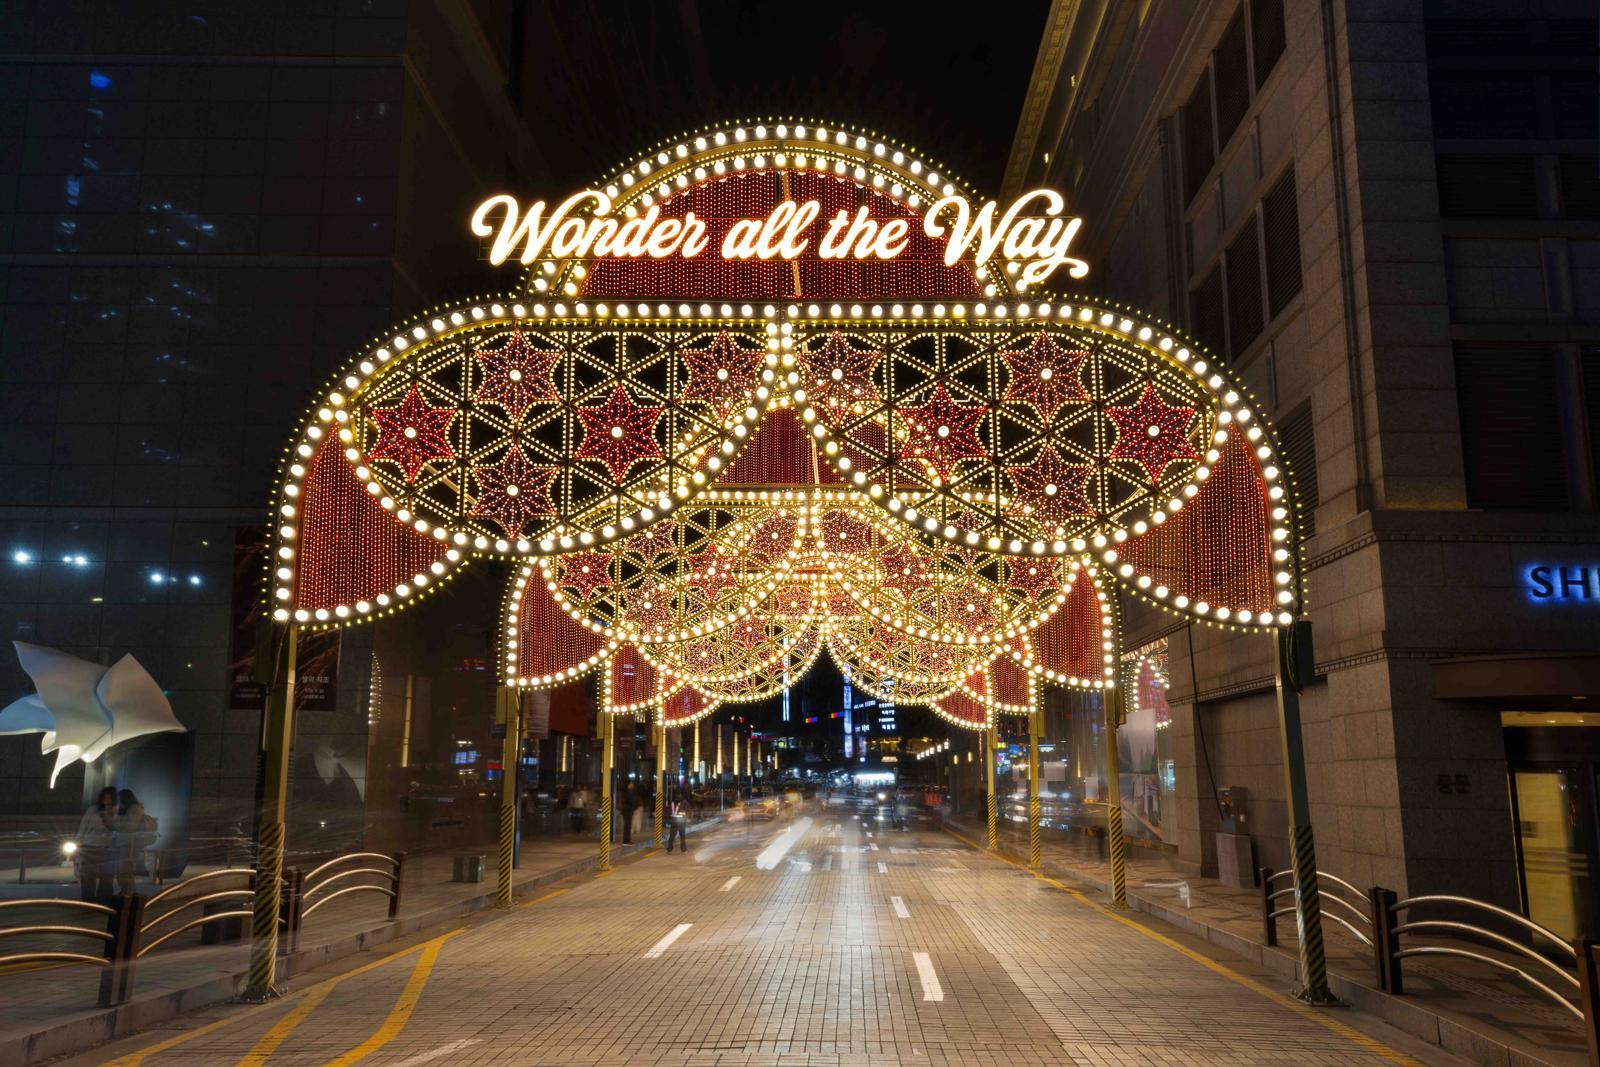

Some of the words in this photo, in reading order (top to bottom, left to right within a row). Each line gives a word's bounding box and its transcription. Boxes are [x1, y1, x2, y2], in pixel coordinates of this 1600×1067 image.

[470, 188, 710, 265] Wonder
[720, 199, 820, 260] all
[818, 204, 910, 260] the
[923, 184, 1090, 292] Way
